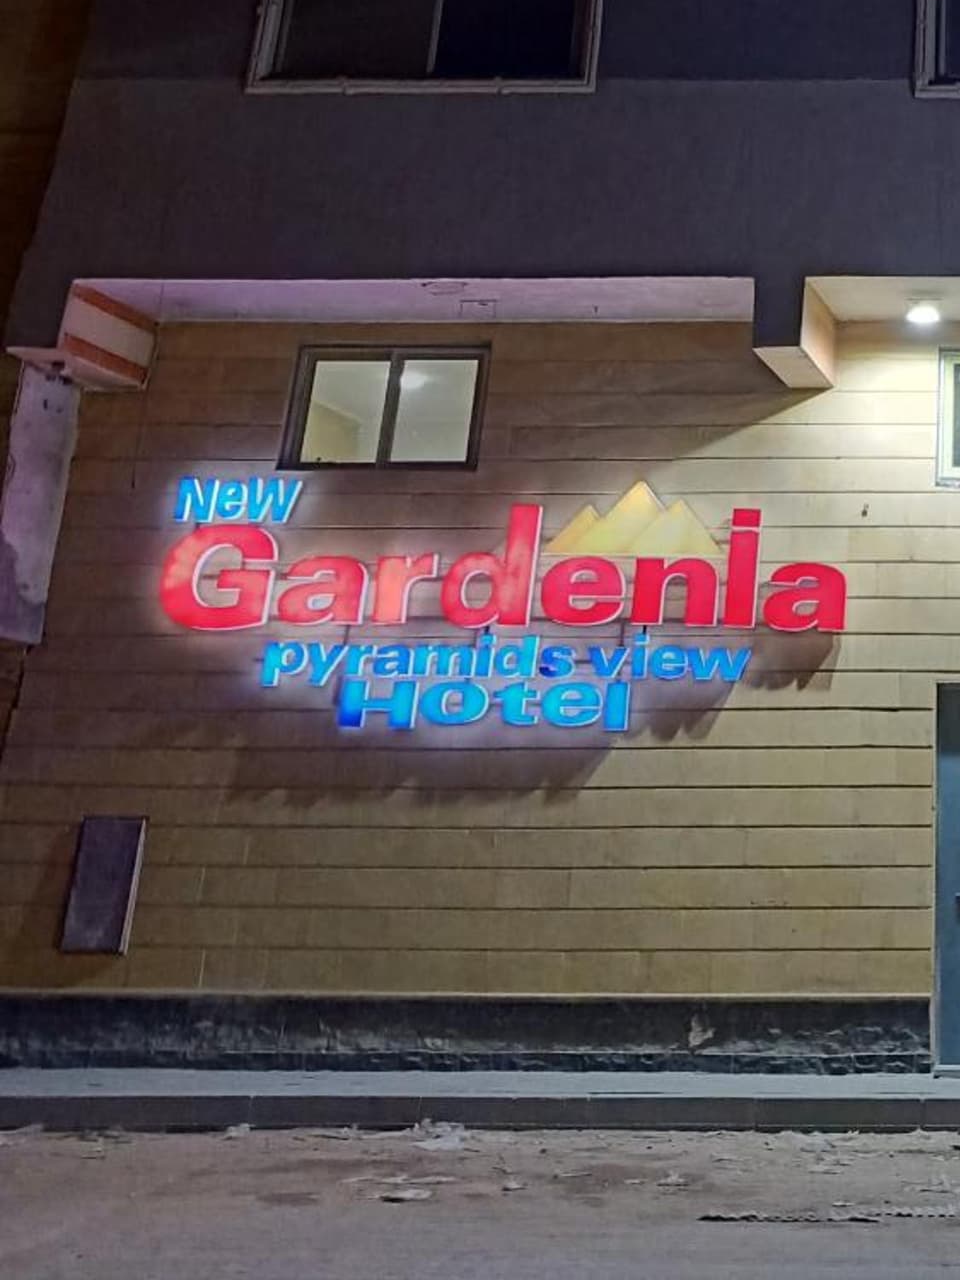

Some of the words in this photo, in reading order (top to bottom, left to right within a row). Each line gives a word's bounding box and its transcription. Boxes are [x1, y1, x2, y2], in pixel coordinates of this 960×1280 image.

[161, 503, 848, 631] Gardenia
[261, 633, 577, 687] pyramids
[588, 631, 752, 681] view
[337, 680, 631, 732] Hotel
